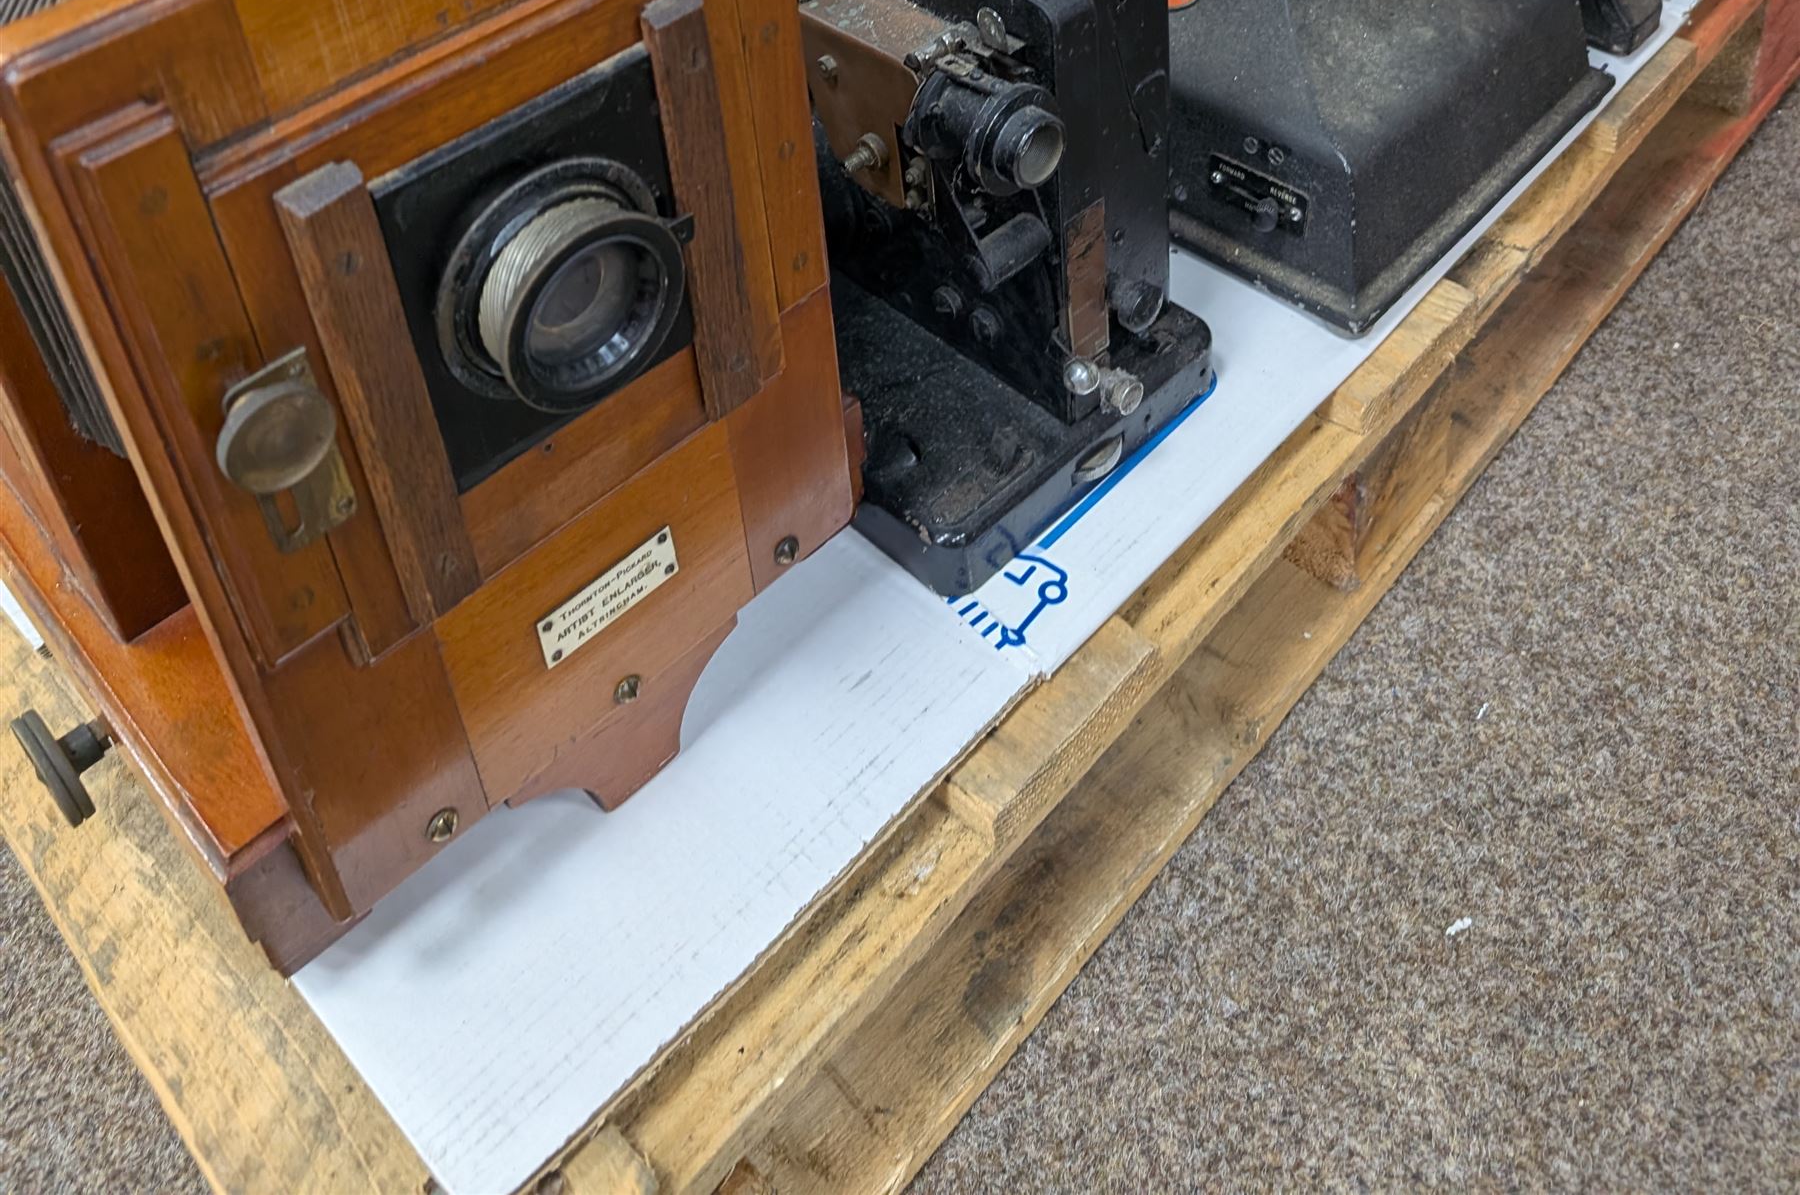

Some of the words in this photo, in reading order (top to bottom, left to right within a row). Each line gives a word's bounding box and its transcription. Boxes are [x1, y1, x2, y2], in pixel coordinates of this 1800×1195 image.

[1219, 164, 1246, 180] FORWARD
[1270, 187, 1297, 205] REVERSE
[556, 607, 597, 643] ARTIST
